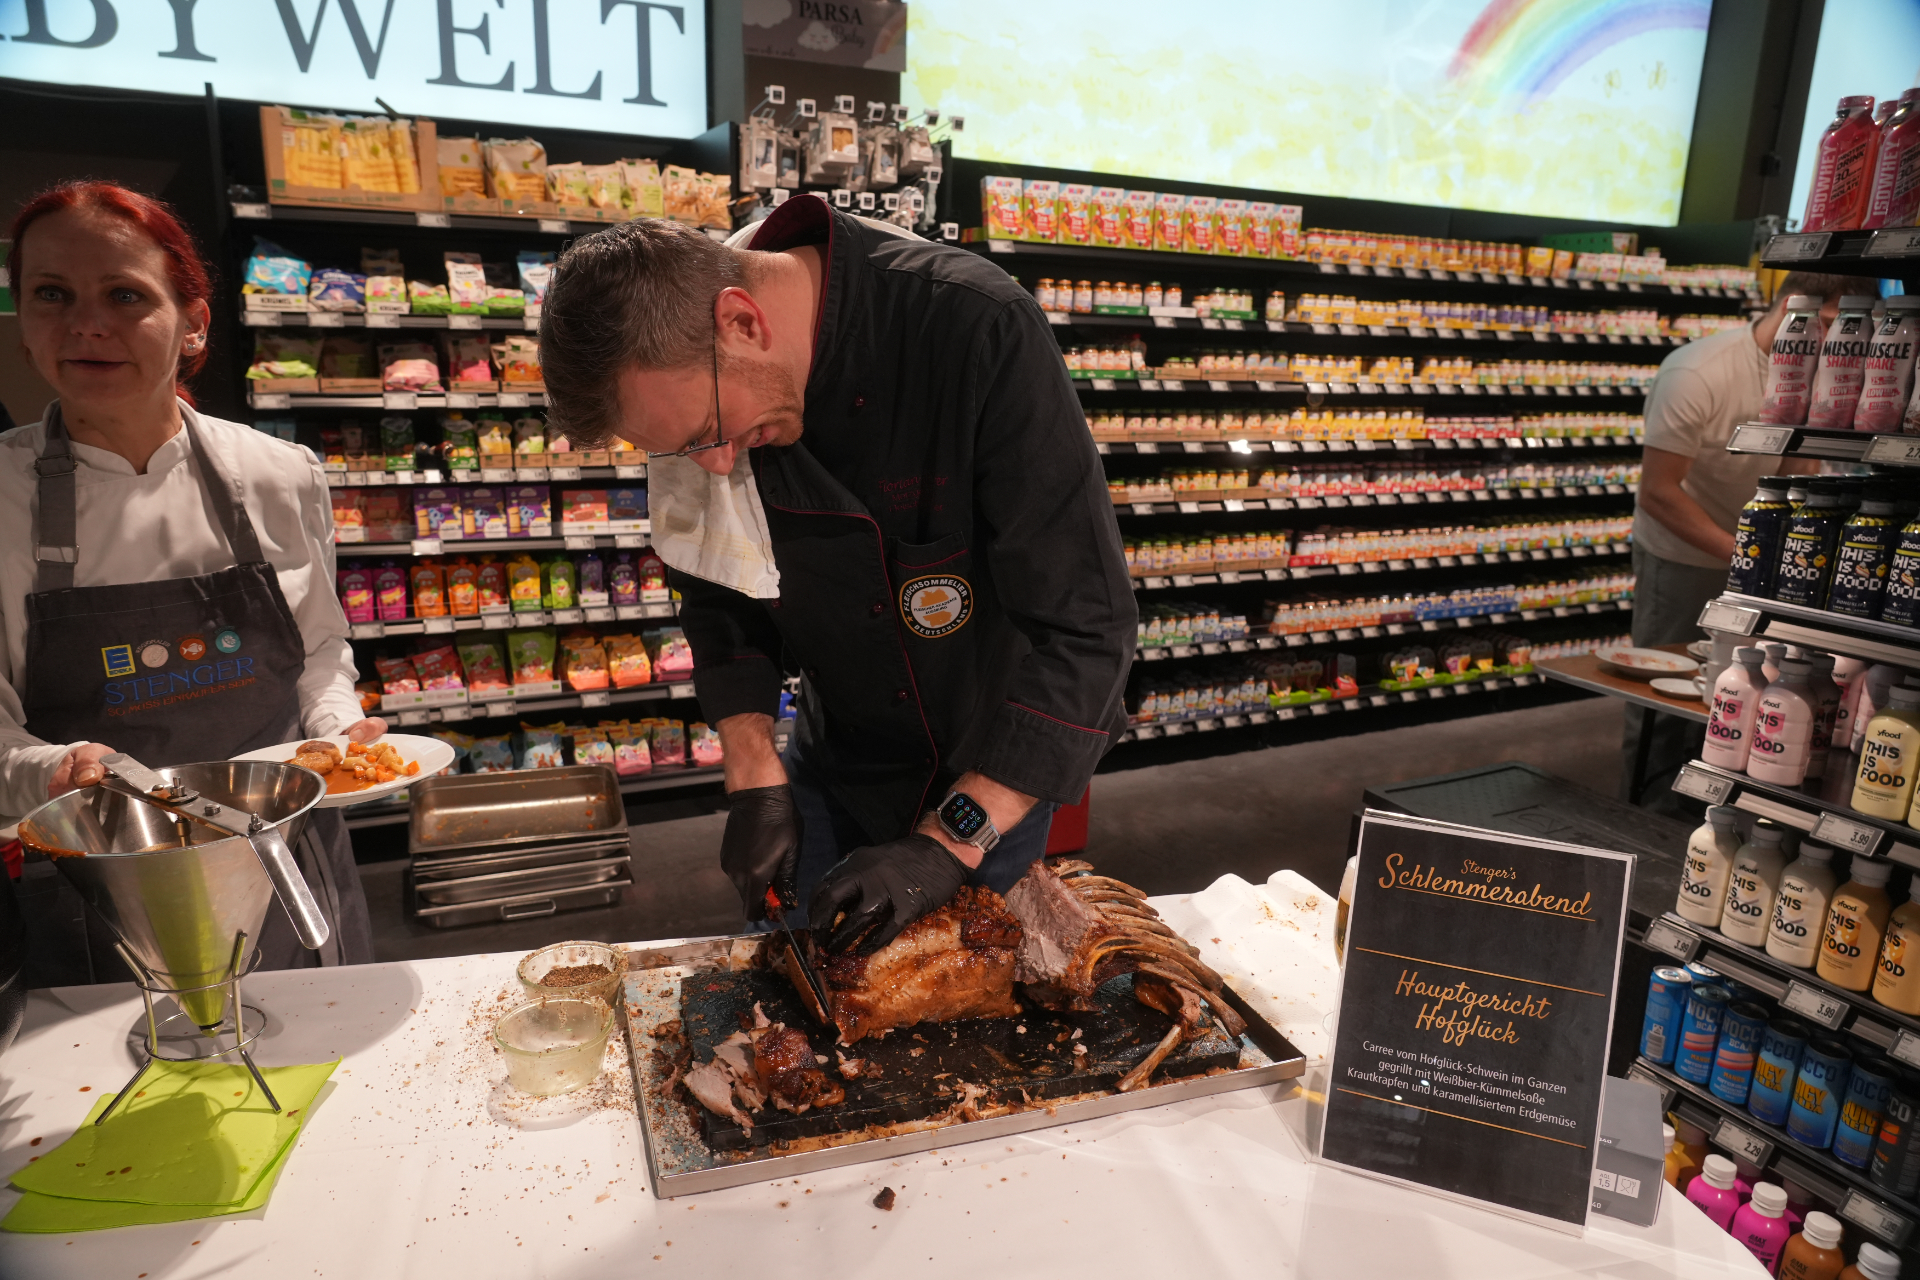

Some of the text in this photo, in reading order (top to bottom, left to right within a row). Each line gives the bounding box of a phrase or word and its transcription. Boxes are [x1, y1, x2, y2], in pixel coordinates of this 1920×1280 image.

[799, 0, 864, 26] PARSA
[273, 0, 686, 108] WELT
[1811, 145, 1838, 218] ISOWHEY
[1873, 139, 1901, 216] ISOWHEY
[1773, 354, 1806, 367] SHAKE
[1826, 355, 1862, 369] SHAKE
[1866, 357, 1897, 371] SHAKE
[1831, 386, 1847, 395] LOW
[1867, 388, 1884, 398] LOW
[1793, 524, 1815, 534] yfood
[1784, 537, 1813, 552] THIS
[1852, 533, 1878, 543] yfood
[1901, 540, 1920, 551] yfoo
[1782, 551, 1793, 564] IS
[1841, 546, 1876, 562] THIS
[1838, 560, 1853, 573] IS
[1892, 554, 1920, 571] THIS
[1780, 563, 1820, 581] FOOD
[1890, 568, 1899, 581] IS
[1835, 573, 1882, 591] FOOD
[903, 578, 968, 612] FLEISCHSOMMELIER
[913, 609, 968, 636] DEUTSCHLAND
[104, 657, 255, 705] STENGER
[1720, 686, 1739, 697] yfood
[108, 707, 125, 717] SO
[1763, 699, 1781, 709] yfood
[1877, 729, 1901, 740] yfood
[1866, 740, 1900, 759] THIS
[1863, 753, 1877, 768] IS
[1860, 767, 1906, 788] FOOD
[1705, 783, 1722, 796] 3.99
[1850, 831, 1870, 845] 3.99
[1691, 845, 1708, 856] yfood
[1461, 859, 1517, 883] Stenger's
[1738, 863, 1758, 875] yfood
[1378, 853, 1592, 915] Schlemmerabend
[1731, 872, 1757, 892] THIS
[1784, 881, 1804, 893] yfood
[1777, 890, 1802, 911] THIS
[1837, 899, 1858, 912] yfood
[1829, 907, 1856, 931] THIS
[1827, 923, 1836, 936] IS
[1674, 939, 1690, 953] 3.99
[1824, 935, 1861, 959] FOOD
[1880, 953, 1905, 978] OOD
[1395, 969, 1552, 1019] Hauptgericht
[1817, 1003, 1836, 1019] 3.99
[1415, 1003, 1520, 1046] Hofglück
[1722, 1015, 1762, 1044] NOCC
[1362, 1040, 1567, 1094] Carree vom Hofglück-Schwein im Ganzen
[1378, 1060, 1546, 1106] gegrillt mit Weißbier-Kümmelsoße
[1347, 1067, 1577, 1129] Krautkrapfen und karamellisiertem Erdgemüse
[1843, 1099, 1880, 1127] JUIC
[1744, 1141, 1762, 1158] 2.29
